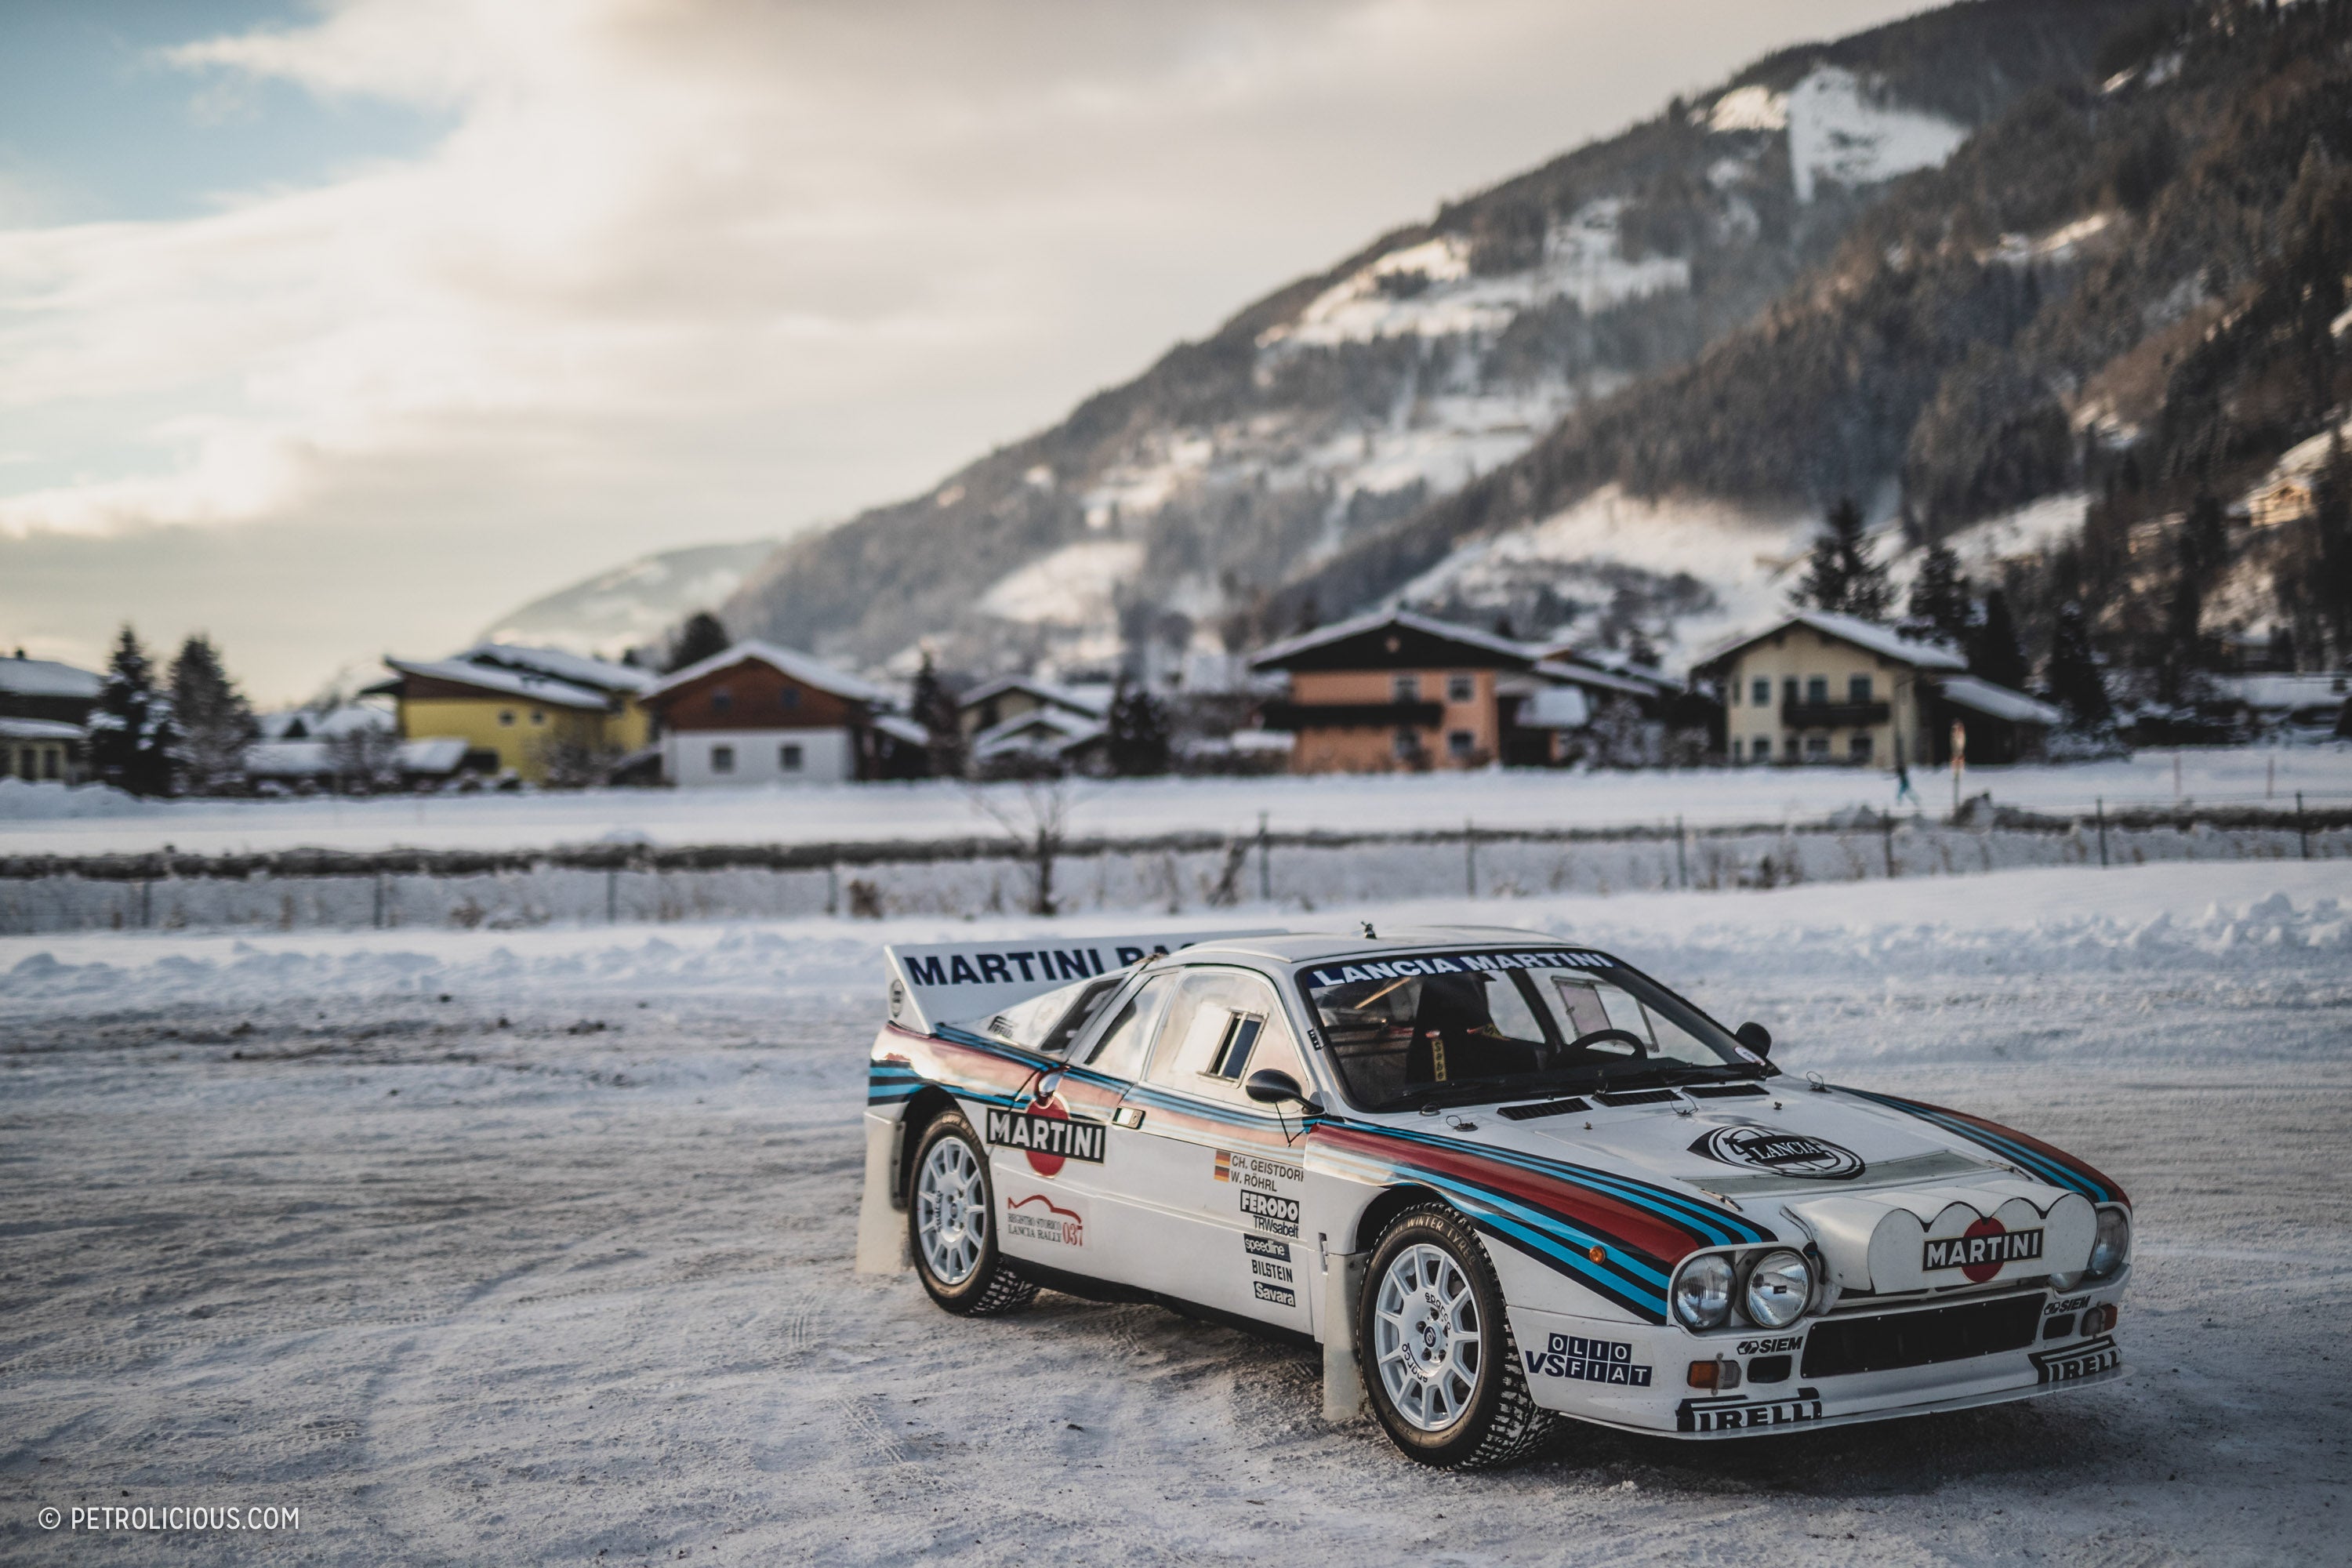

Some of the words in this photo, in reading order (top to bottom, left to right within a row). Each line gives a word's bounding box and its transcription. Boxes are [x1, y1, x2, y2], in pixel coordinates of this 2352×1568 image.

[903, 949, 1105, 986] MARTINI
[1313, 957, 1462, 987] LANCIA
[1459, 953, 1613, 971] MARTINI
[989, 1111, 1102, 1159] MARTINI
[1232, 1156, 1248, 1169] CH.
[1750, 1141, 1820, 1160] LANCIA
[1231, 1171, 1242, 1184] W.
[1243, 1173, 1277, 1192] RÖHRL
[1241, 1192, 1298, 1221] FERODO
[1008, 1224, 1035, 1238] LANCIA
[1062, 1222, 1083, 1247] 037
[1407, 1215, 1444, 1232] WINTER
[1244, 1238, 1286, 1256] speedline
[1927, 1232, 2039, 1268] MARTINI
[1251, 1259, 1293, 1283] BILSTEIN
[1255, 1283, 1295, 1306] Savara
[2060, 1295, 2092, 1313] SIEM
[1425, 1292, 1451, 1330] sparco
[1552, 1336, 1628, 1360] OLIO
[1759, 1336, 1803, 1353] SIEM
